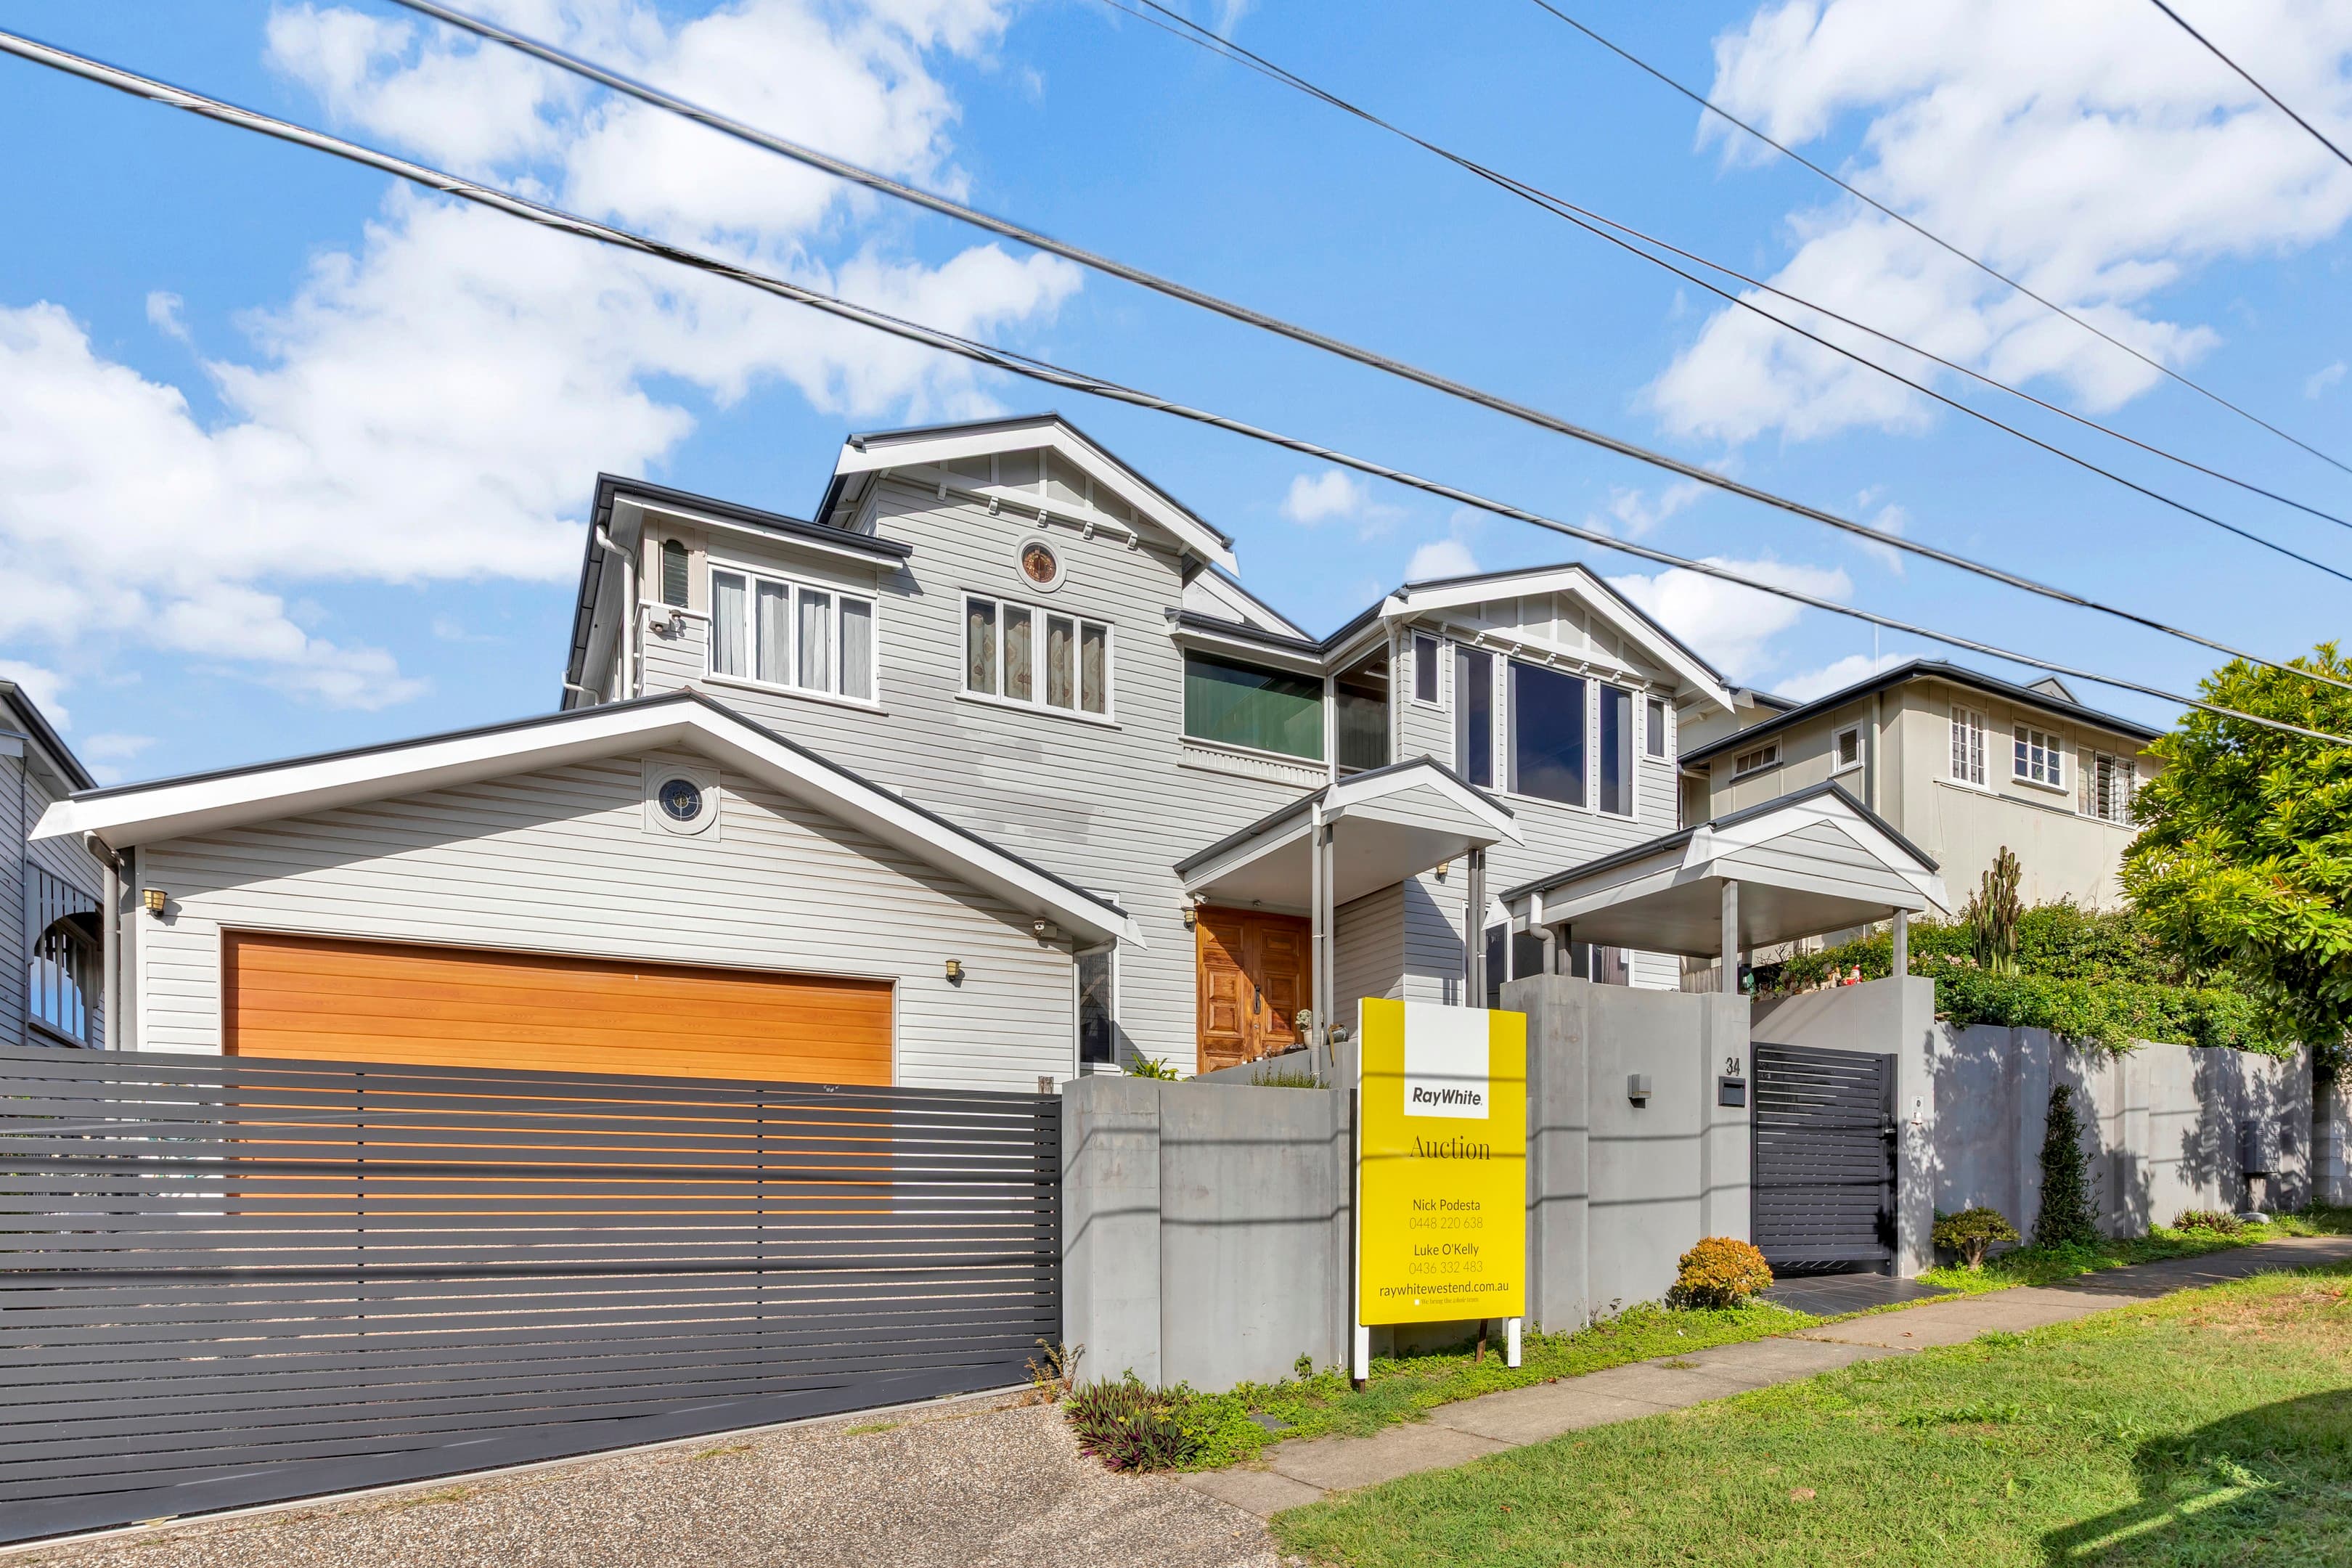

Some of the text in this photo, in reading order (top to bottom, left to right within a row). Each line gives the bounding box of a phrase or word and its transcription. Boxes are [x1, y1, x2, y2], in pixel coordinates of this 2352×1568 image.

[1726, 1057, 1740, 1077] 34
[1409, 1135, 1490, 1160] Auction
[1413, 1199, 1481, 1211] Nick Podesta
[1409, 1217, 1483, 1230] 0448 220 638
[1414, 1243, 1479, 1257] Luke O'Kelly
[1408, 1261, 1483, 1275] 0436 332 483
[1379, 1281, 1509, 1298] raywhitewestend.com.au
